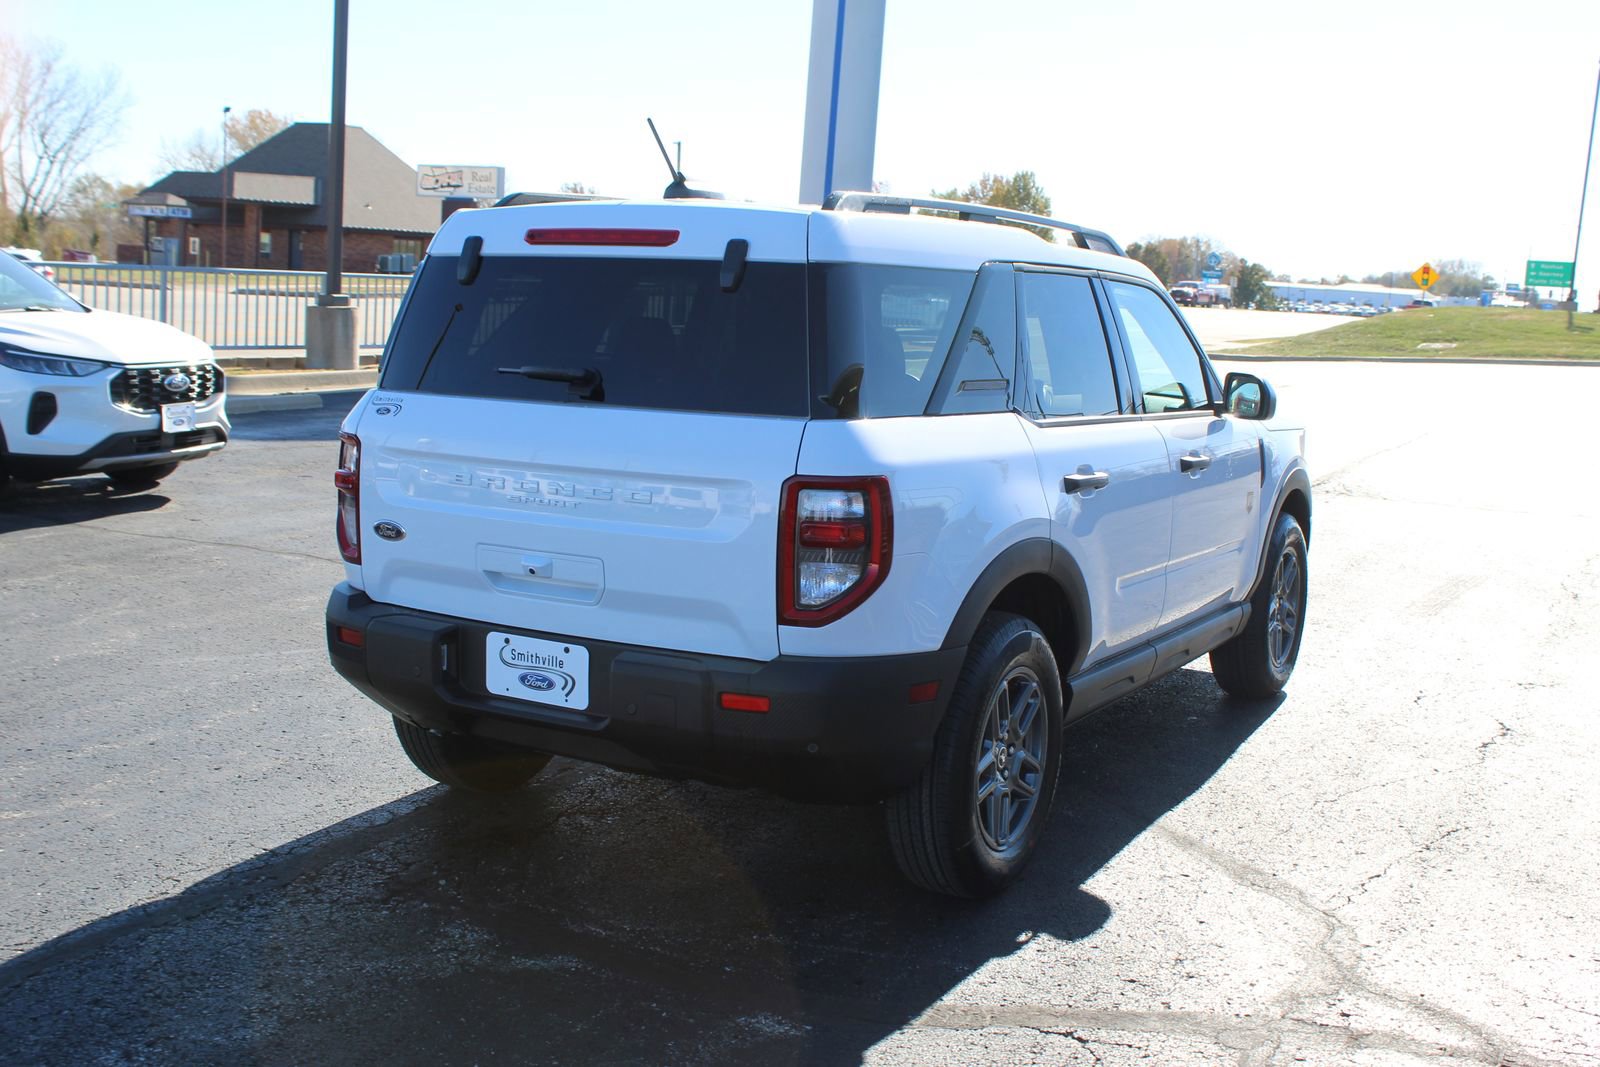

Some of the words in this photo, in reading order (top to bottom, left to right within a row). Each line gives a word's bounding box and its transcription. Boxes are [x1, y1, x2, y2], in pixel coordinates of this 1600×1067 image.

[471, 171, 492, 182] Real
[451, 472, 653, 505] BRONCO
[510, 648, 564, 669] Smithville
[524, 674, 549, 689] Ford
